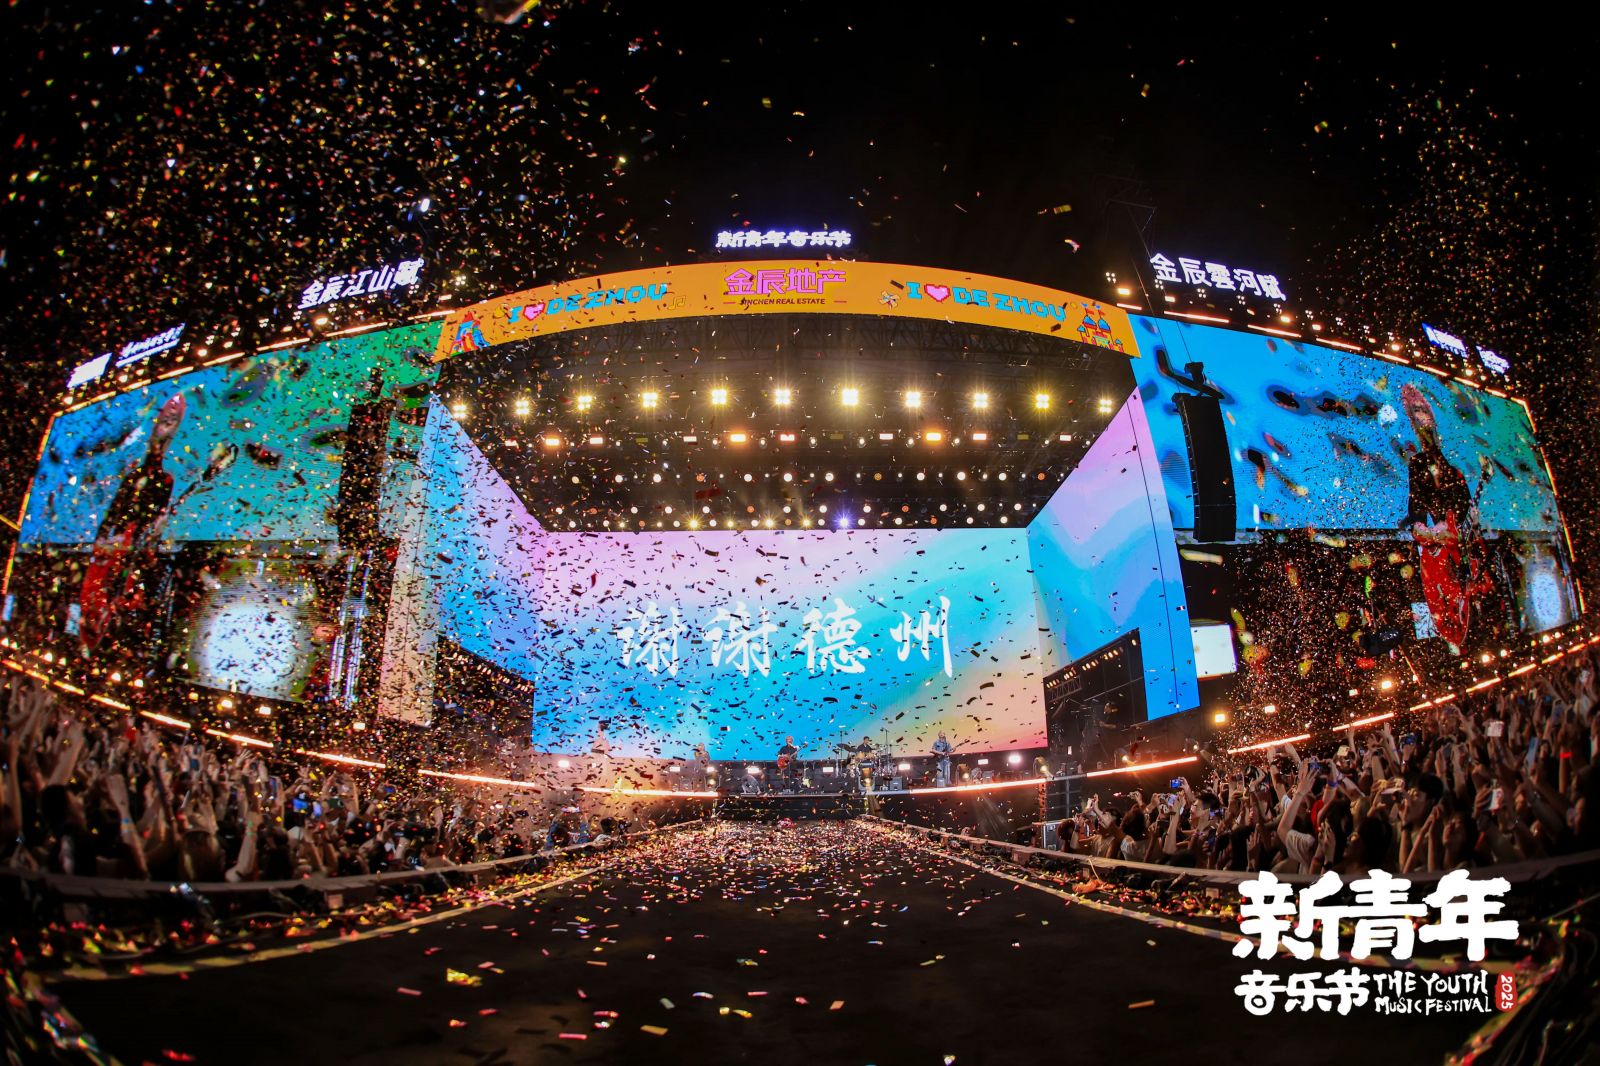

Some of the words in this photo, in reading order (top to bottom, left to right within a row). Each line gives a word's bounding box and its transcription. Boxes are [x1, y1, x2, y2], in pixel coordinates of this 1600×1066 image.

[715, 230, 852, 248] 新青年音乐节
[724, 267, 847, 296] 金辰地产
[906, 281, 923, 300] I
[507, 305, 523, 324] I
[614, 596, 953, 678] 谢谢德州
